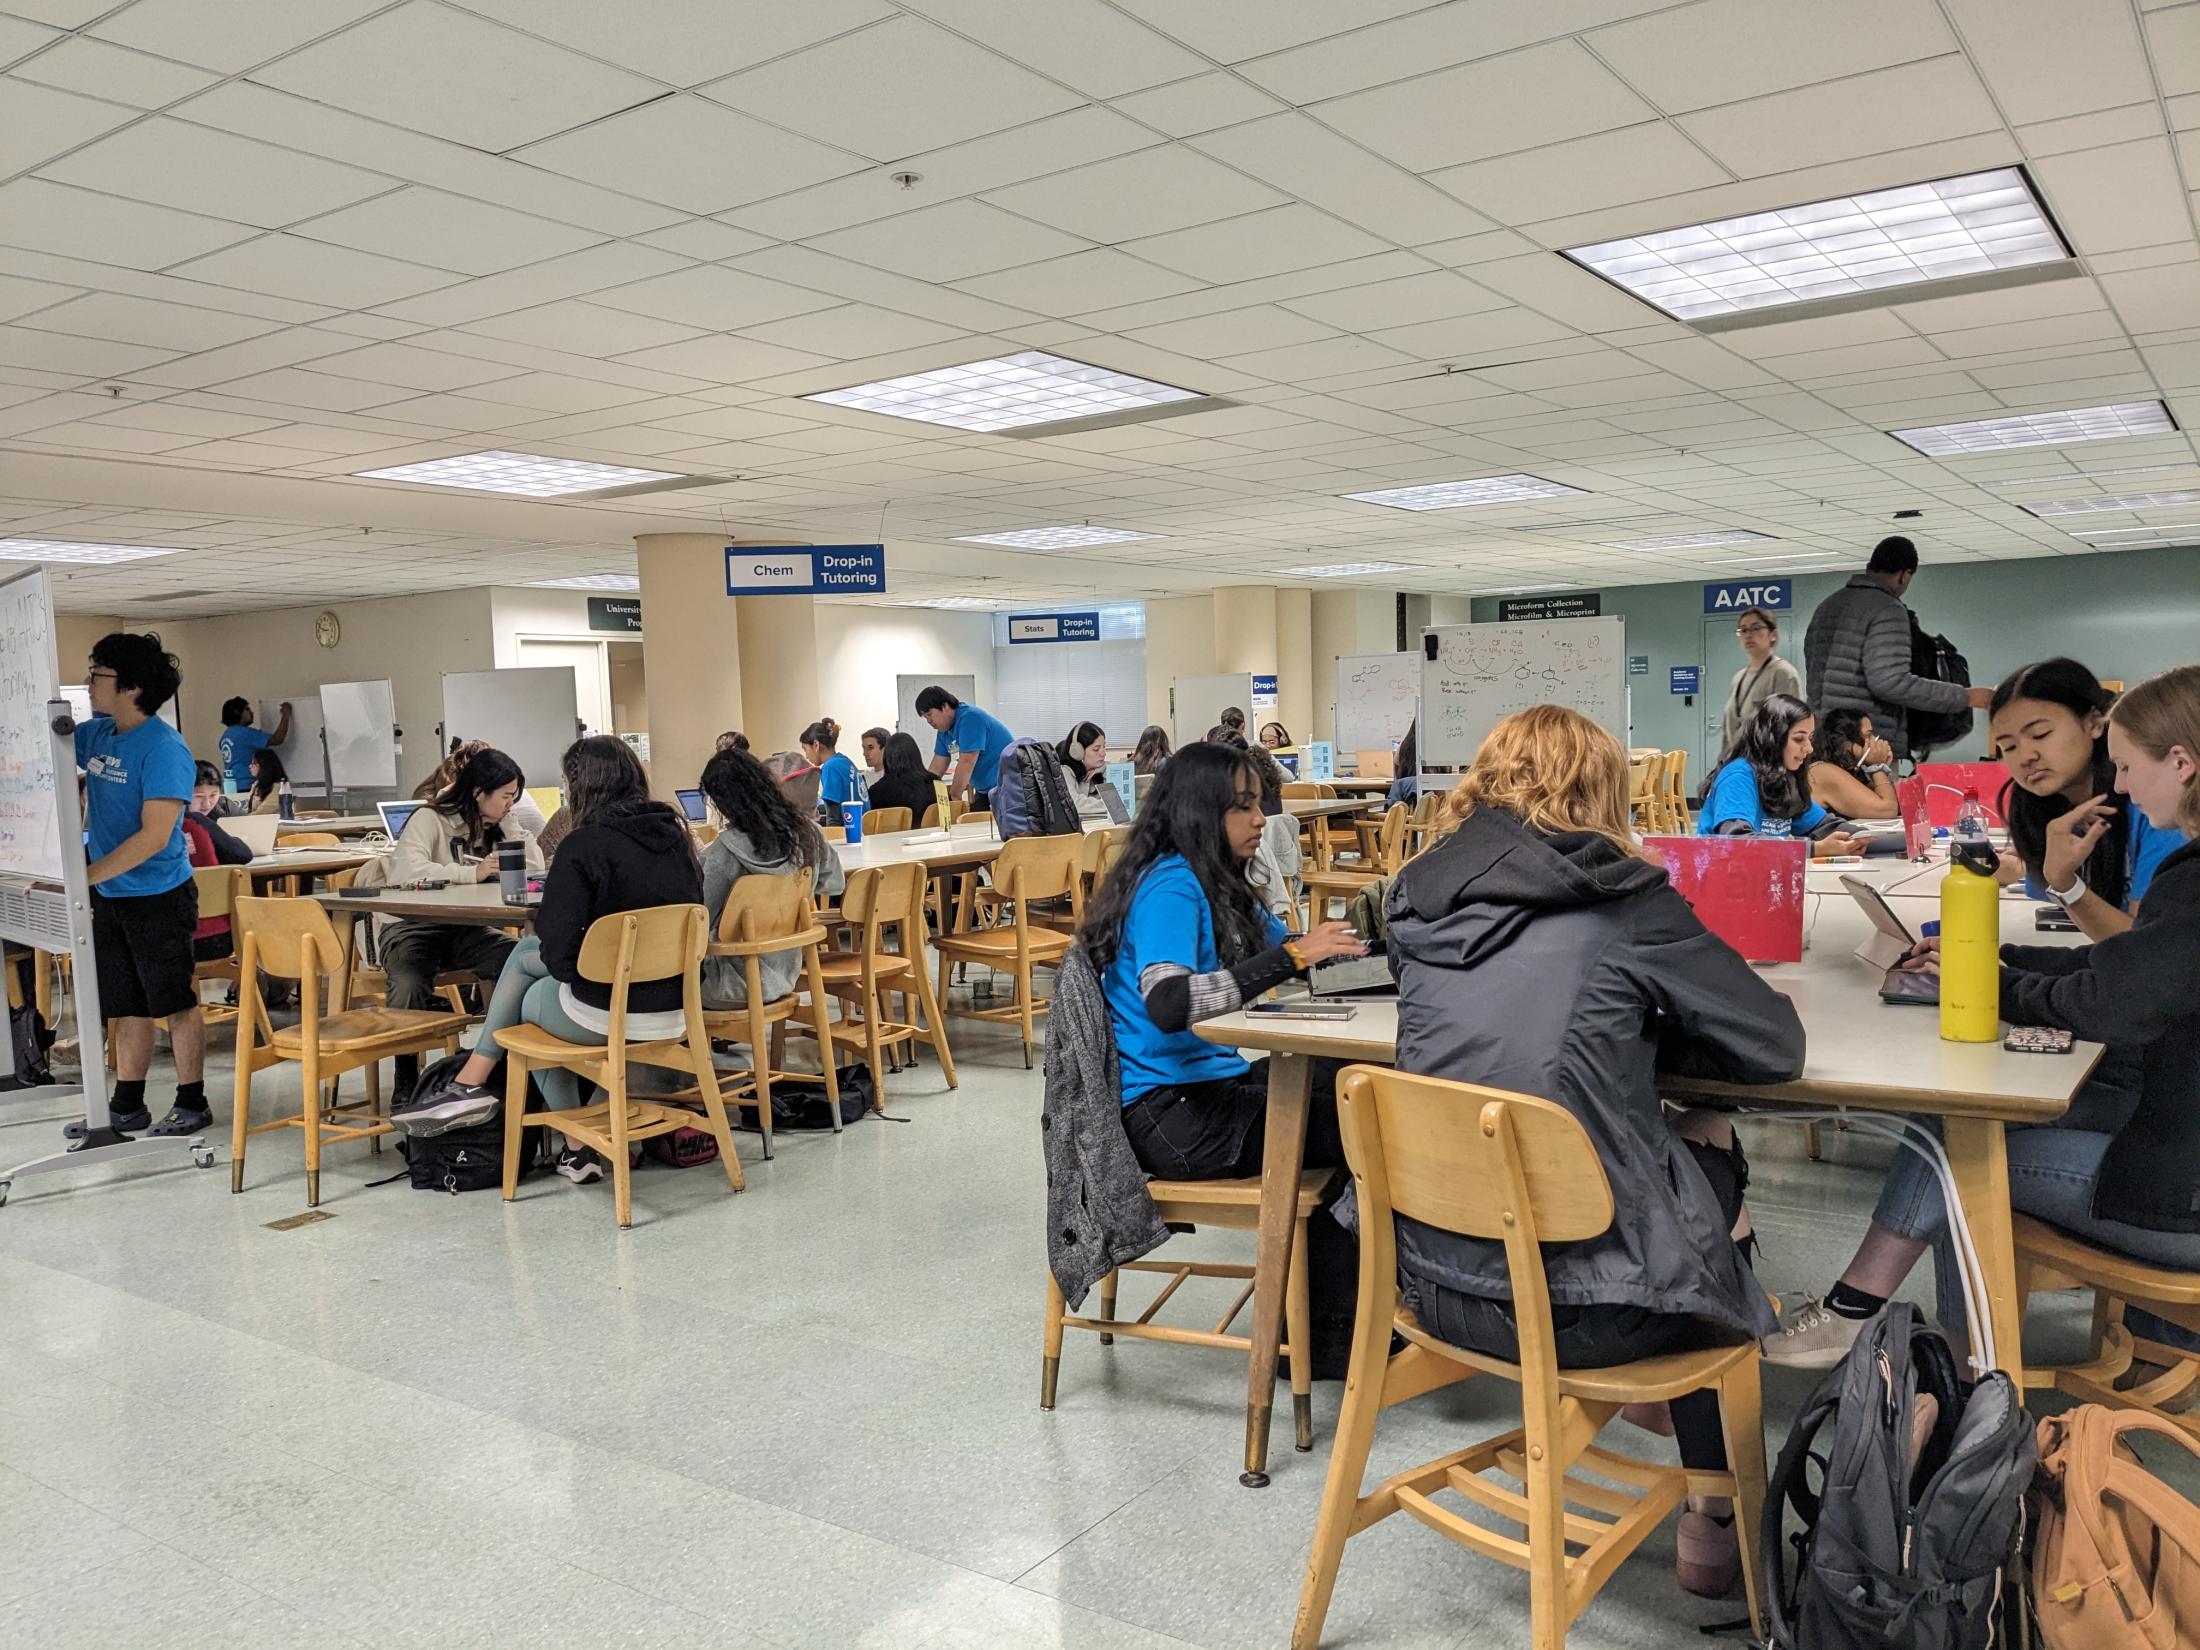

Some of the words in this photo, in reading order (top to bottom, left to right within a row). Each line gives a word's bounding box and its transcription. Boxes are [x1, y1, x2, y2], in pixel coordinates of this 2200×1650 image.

[823, 555, 873, 569] Drop-in
[753, 565, 793, 576] Chem
[821, 572, 877, 585] Tutoring
[1714, 585, 1781, 608] AATC
[606, 603, 642, 614] Universit
[1507, 602, 1545, 611] Microform
[1547, 599, 1584, 608] Collection
[1507, 611, 1543, 620] Microfilm
[1556, 608, 1596, 617] Microprint
[627, 617, 642, 627] Pro
[1063, 618, 1093, 628] Drop-in
[1024, 625, 1045, 633] Stats
[1062, 628, 1095, 638] Tutoring
